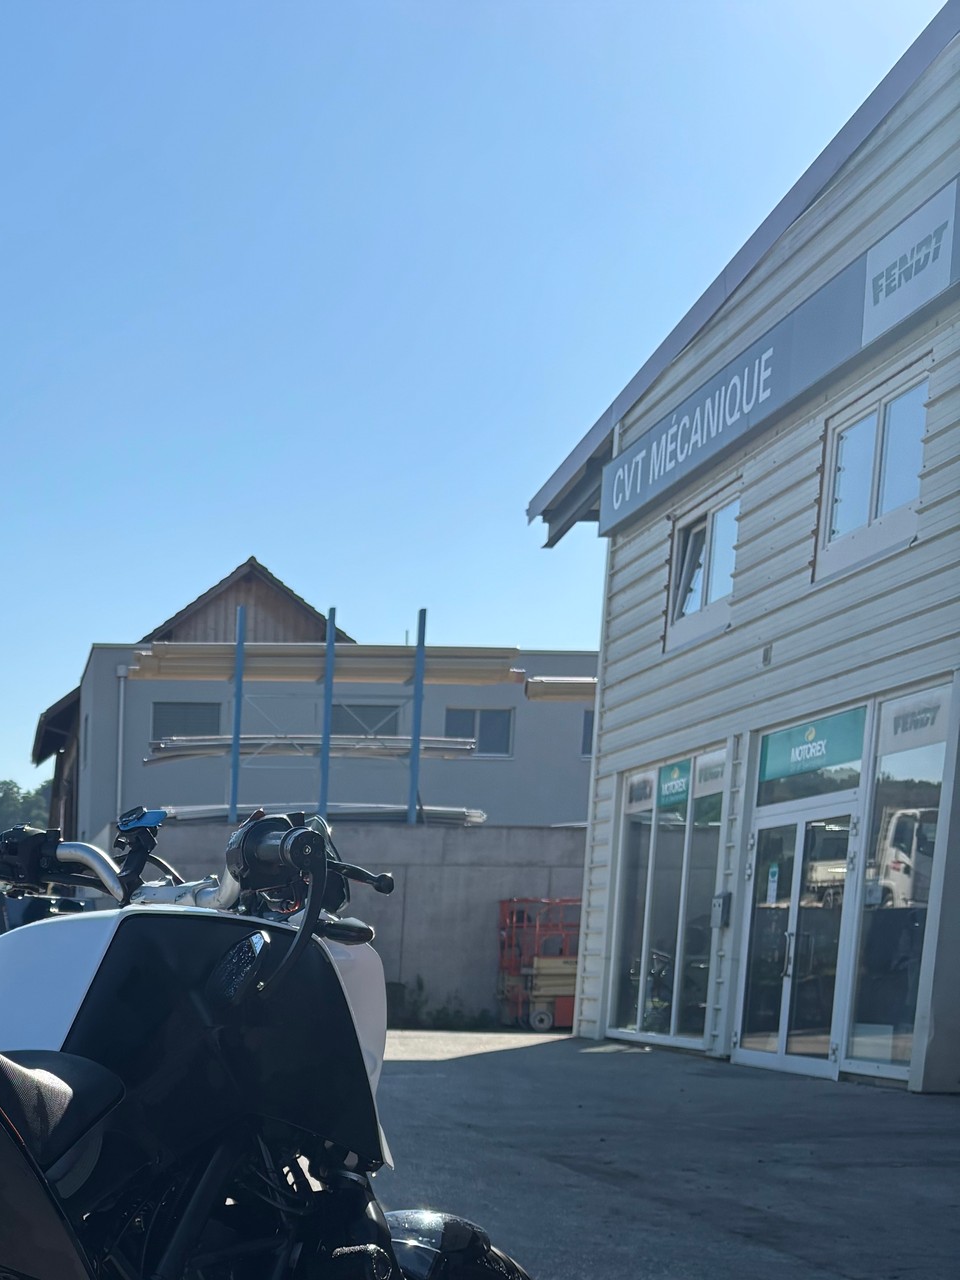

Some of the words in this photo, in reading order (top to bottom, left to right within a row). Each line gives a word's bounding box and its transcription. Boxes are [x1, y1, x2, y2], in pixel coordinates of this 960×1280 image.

[872, 220, 948, 306] FENDT
[613, 450, 646, 510] CVT
[649, 347, 774, 485] MÉCANIQUE
[790, 737, 827, 762] MOTOREX
[661, 778, 687, 796] MOTOREX
